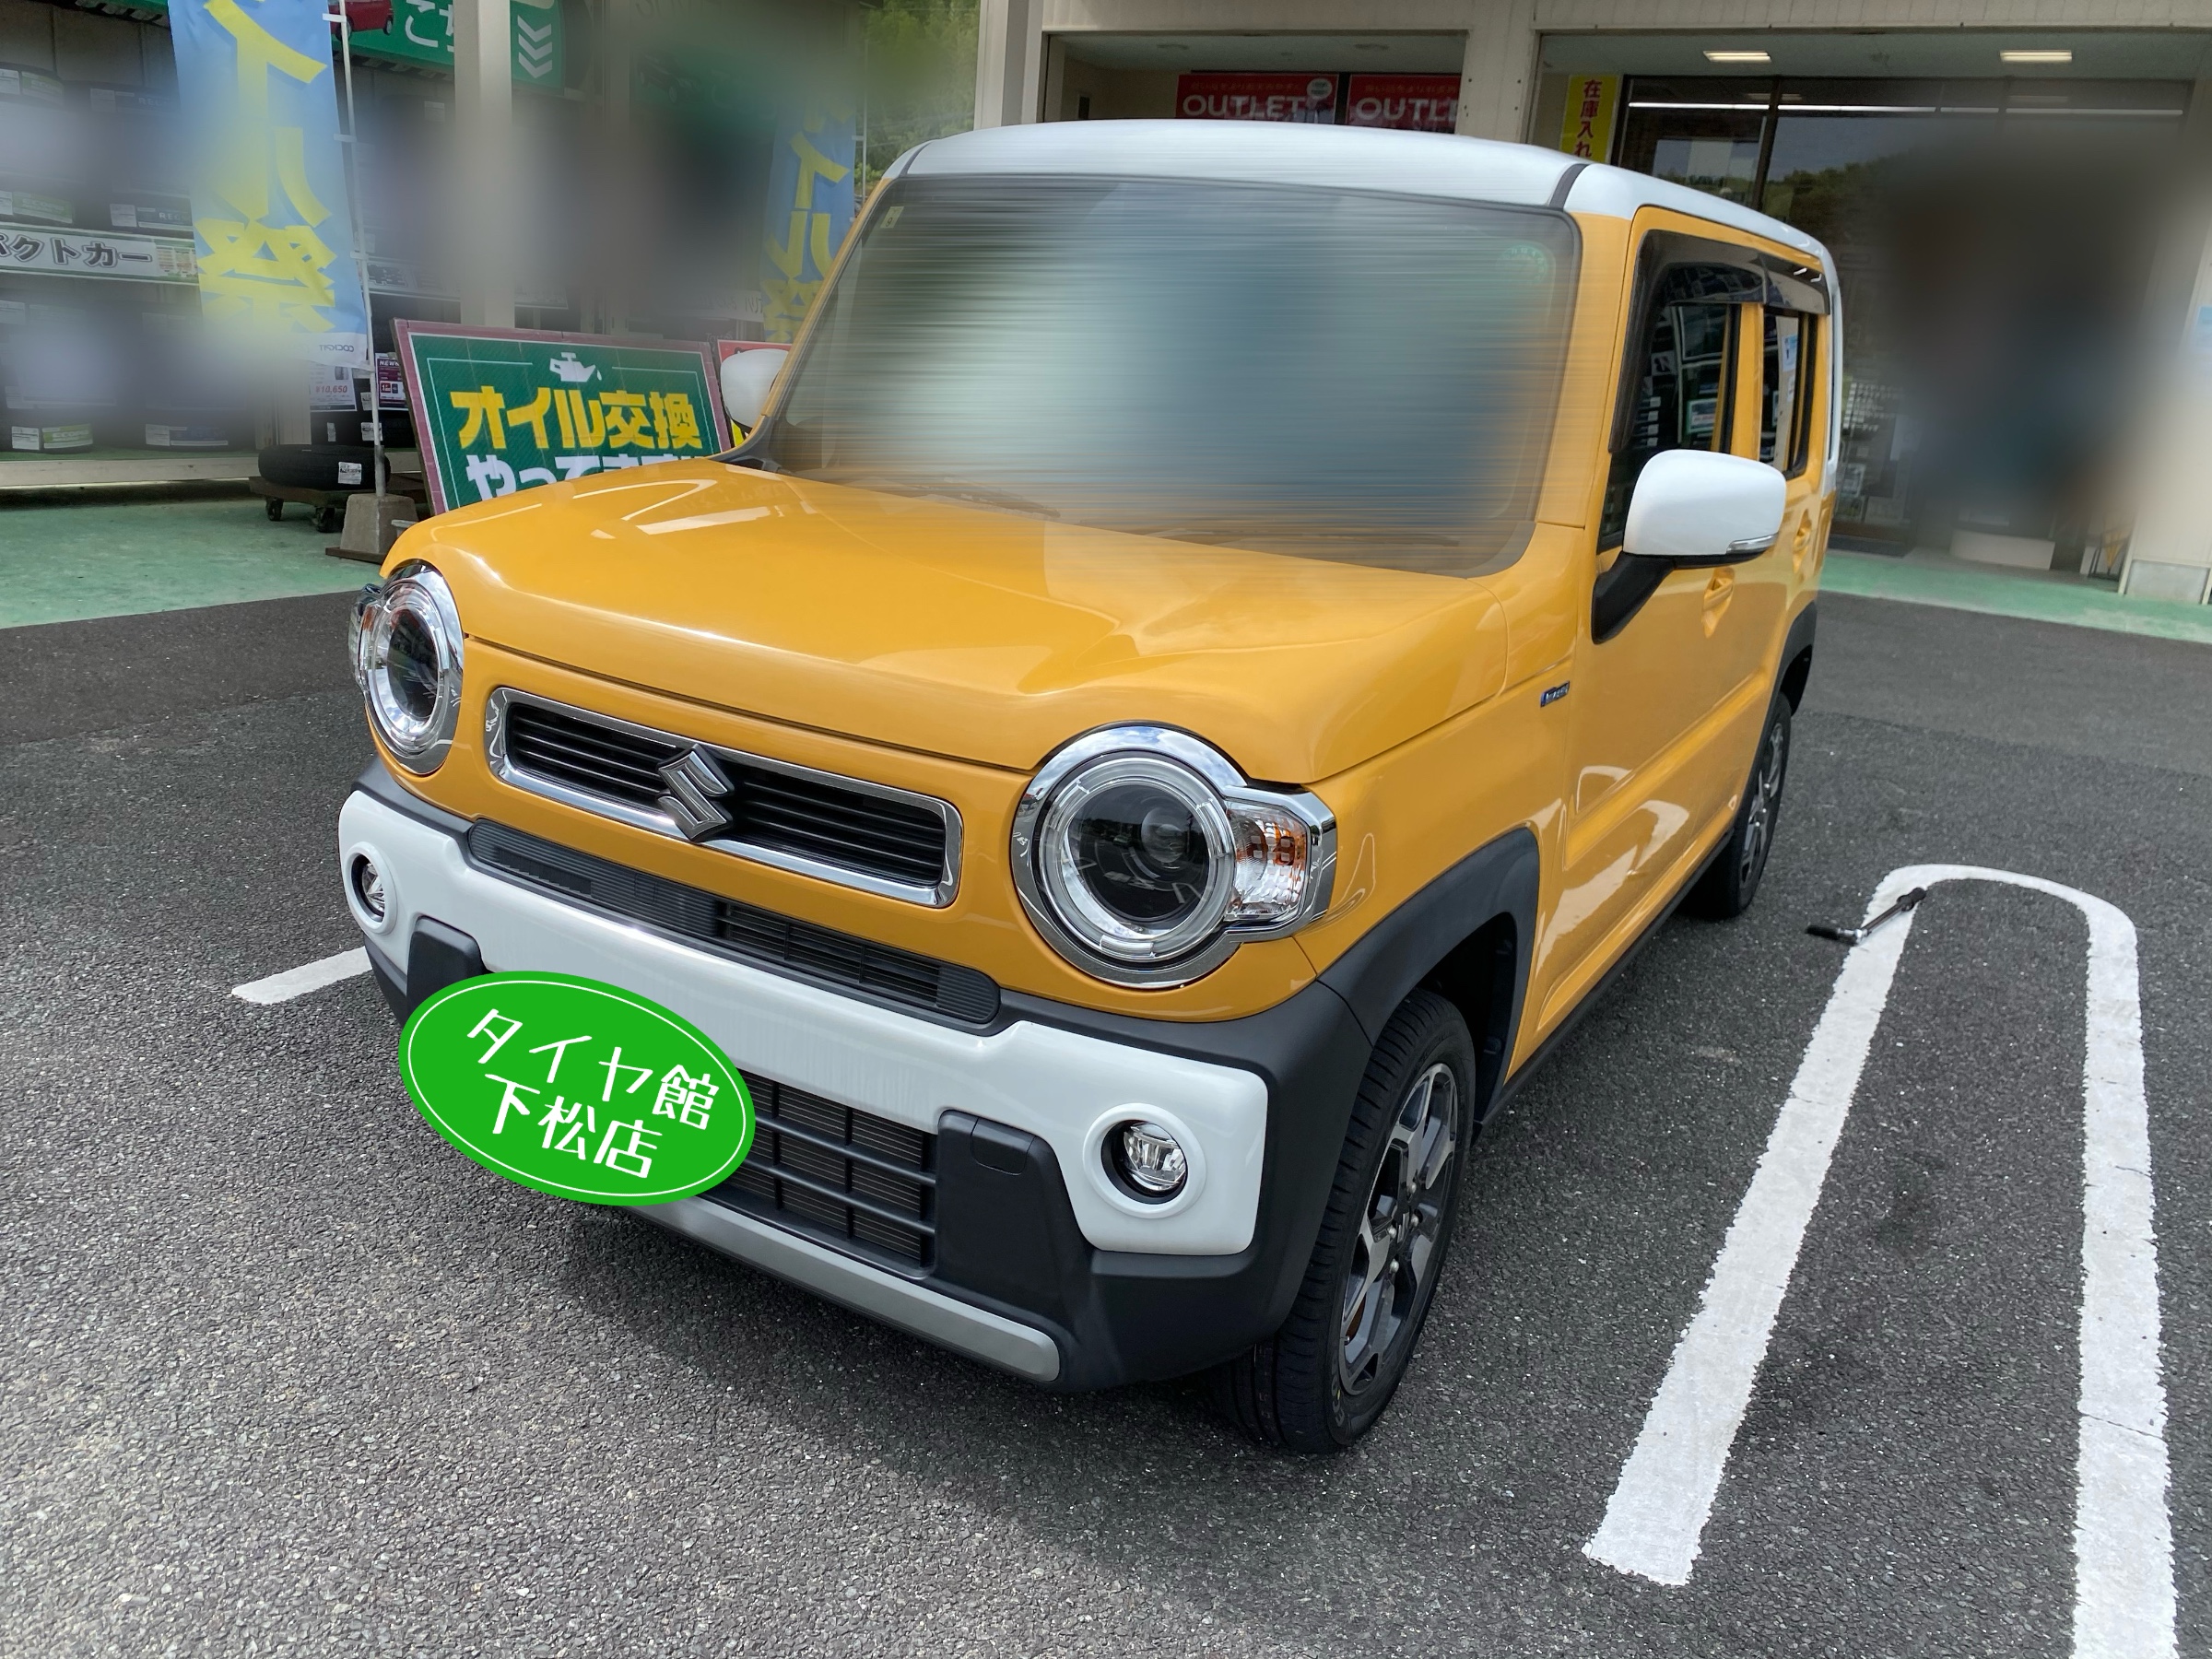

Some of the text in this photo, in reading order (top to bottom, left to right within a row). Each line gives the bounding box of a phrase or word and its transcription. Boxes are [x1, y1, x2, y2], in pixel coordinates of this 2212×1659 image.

[1182, 94, 1307, 120] OUTLET
[1574, 79, 1603, 158] 在庫入れ
[450, 385, 703, 450] オイル交換
